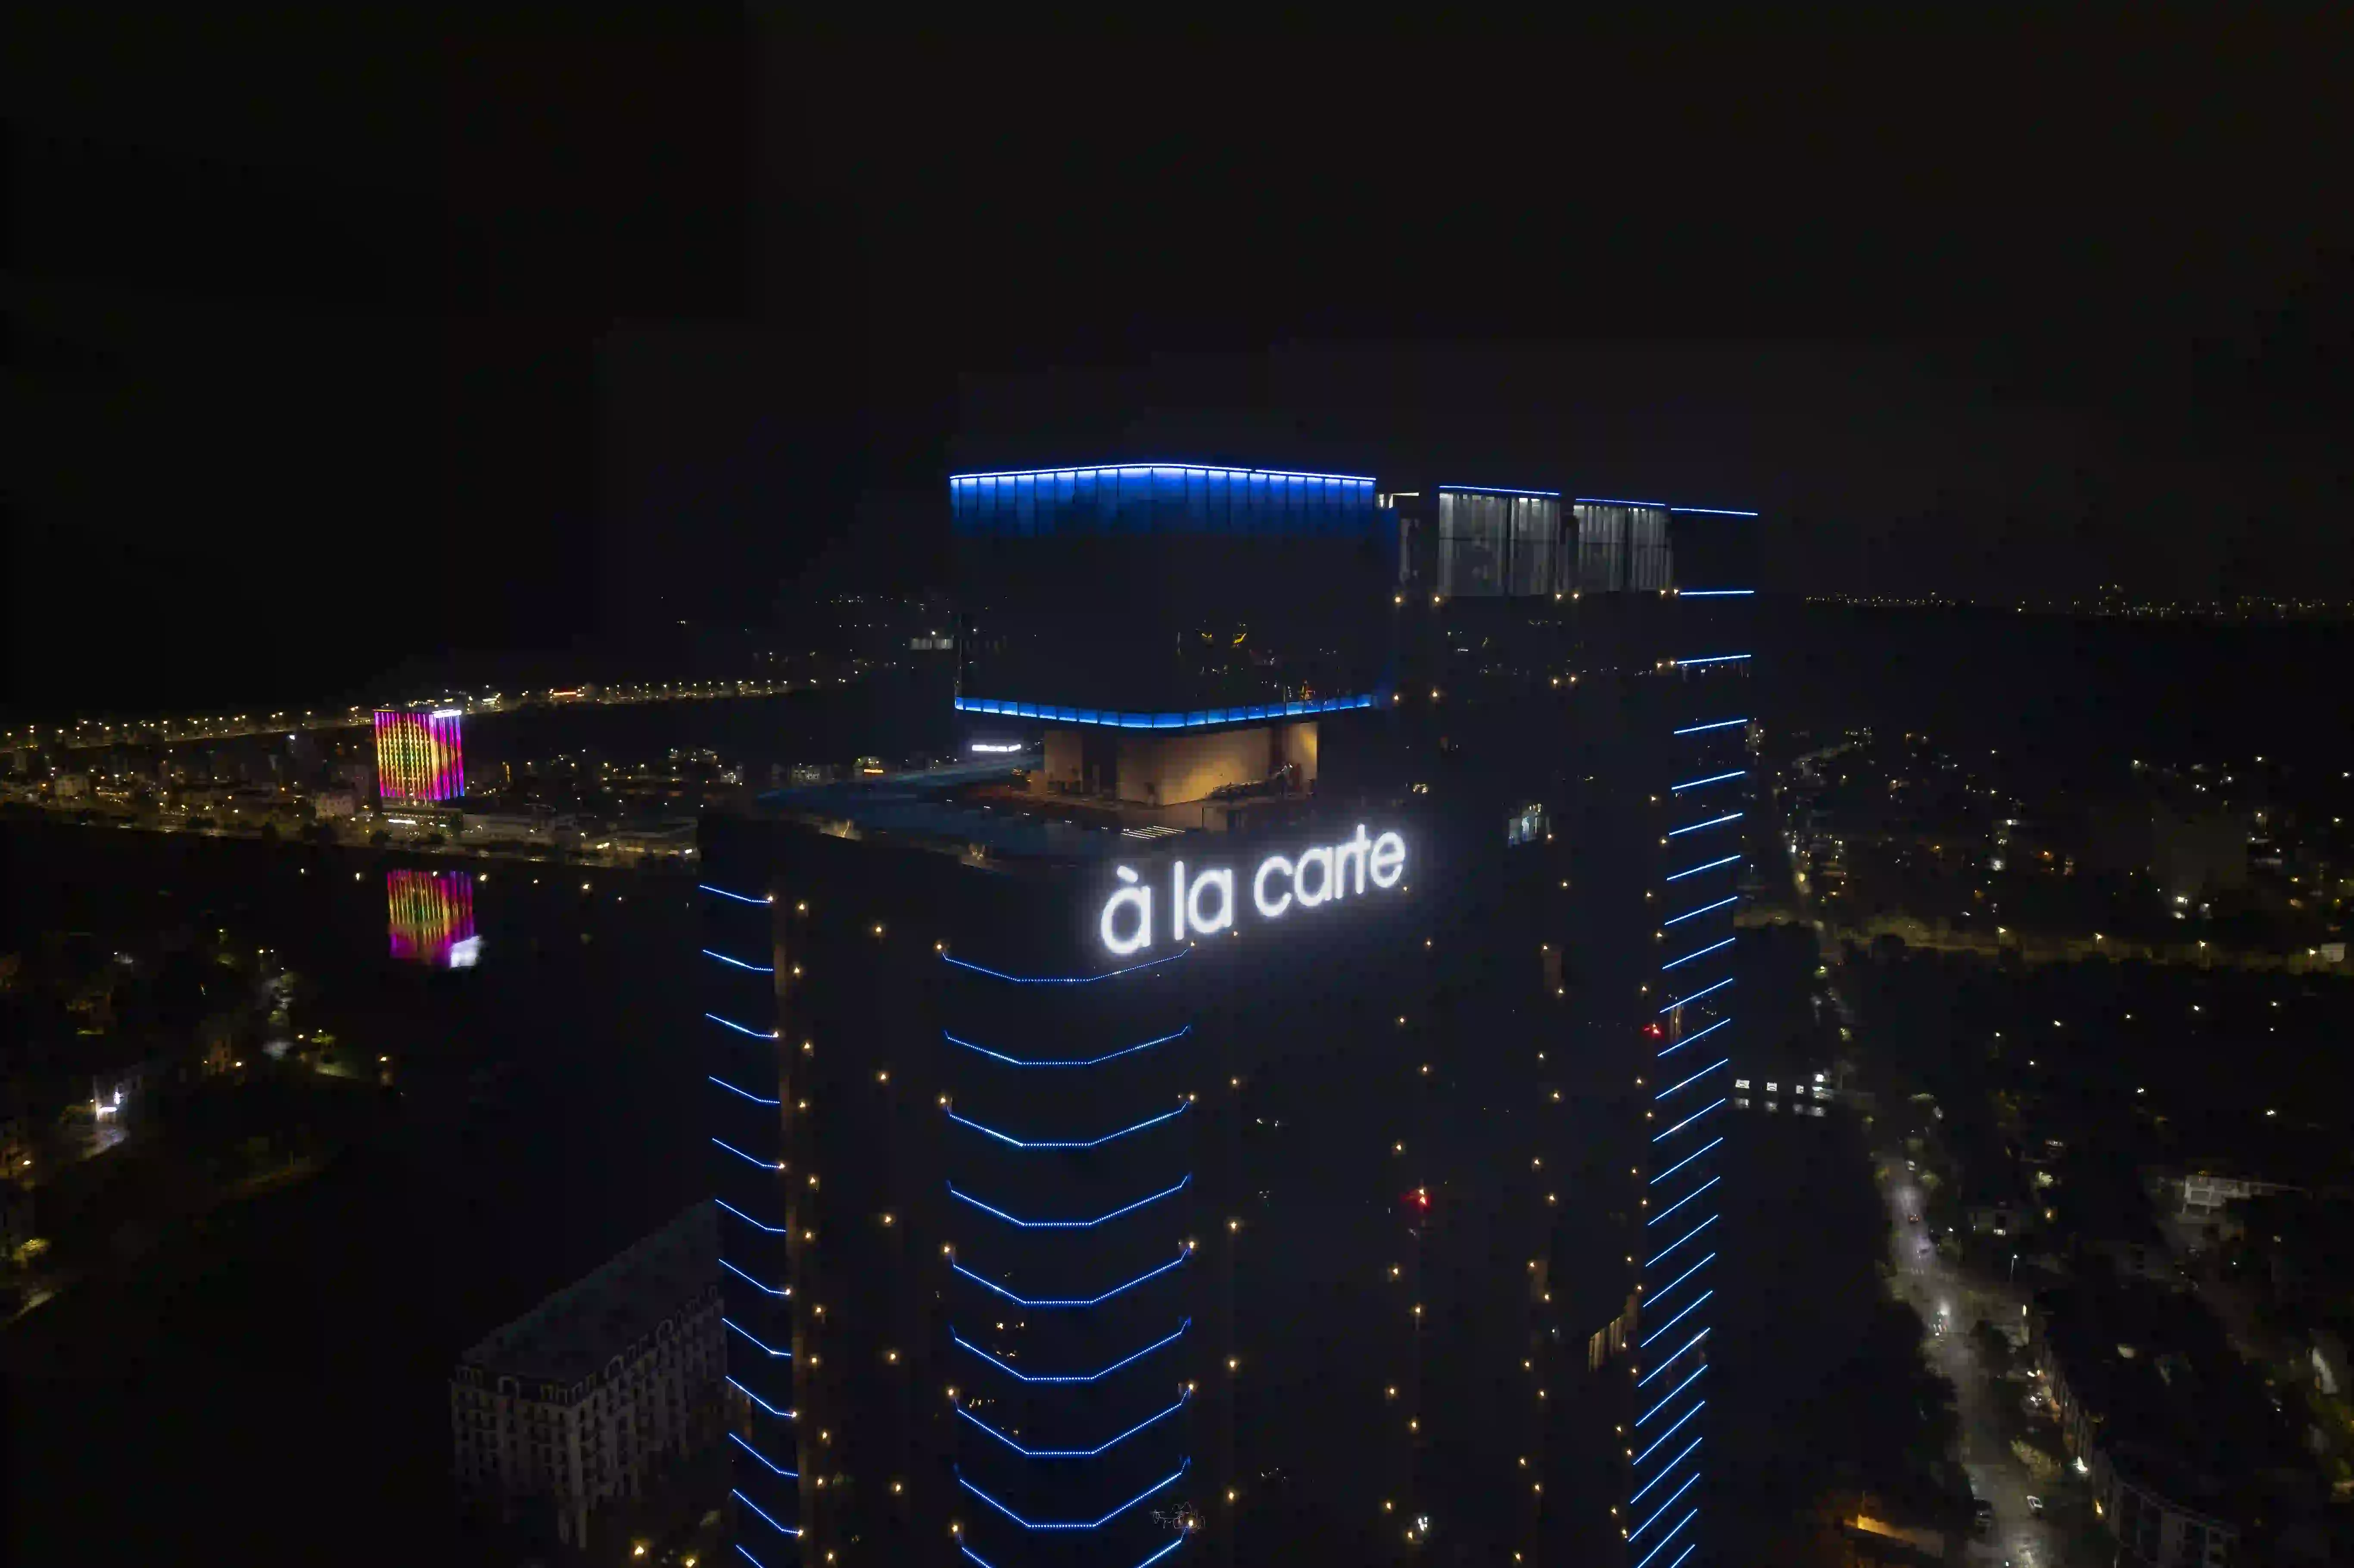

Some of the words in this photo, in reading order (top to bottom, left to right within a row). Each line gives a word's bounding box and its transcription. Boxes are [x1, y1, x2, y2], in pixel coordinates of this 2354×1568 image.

[1100, 865, 1152, 955] à
[1174, 861, 1233, 940] la
[1254, 824, 1405, 917] carte
